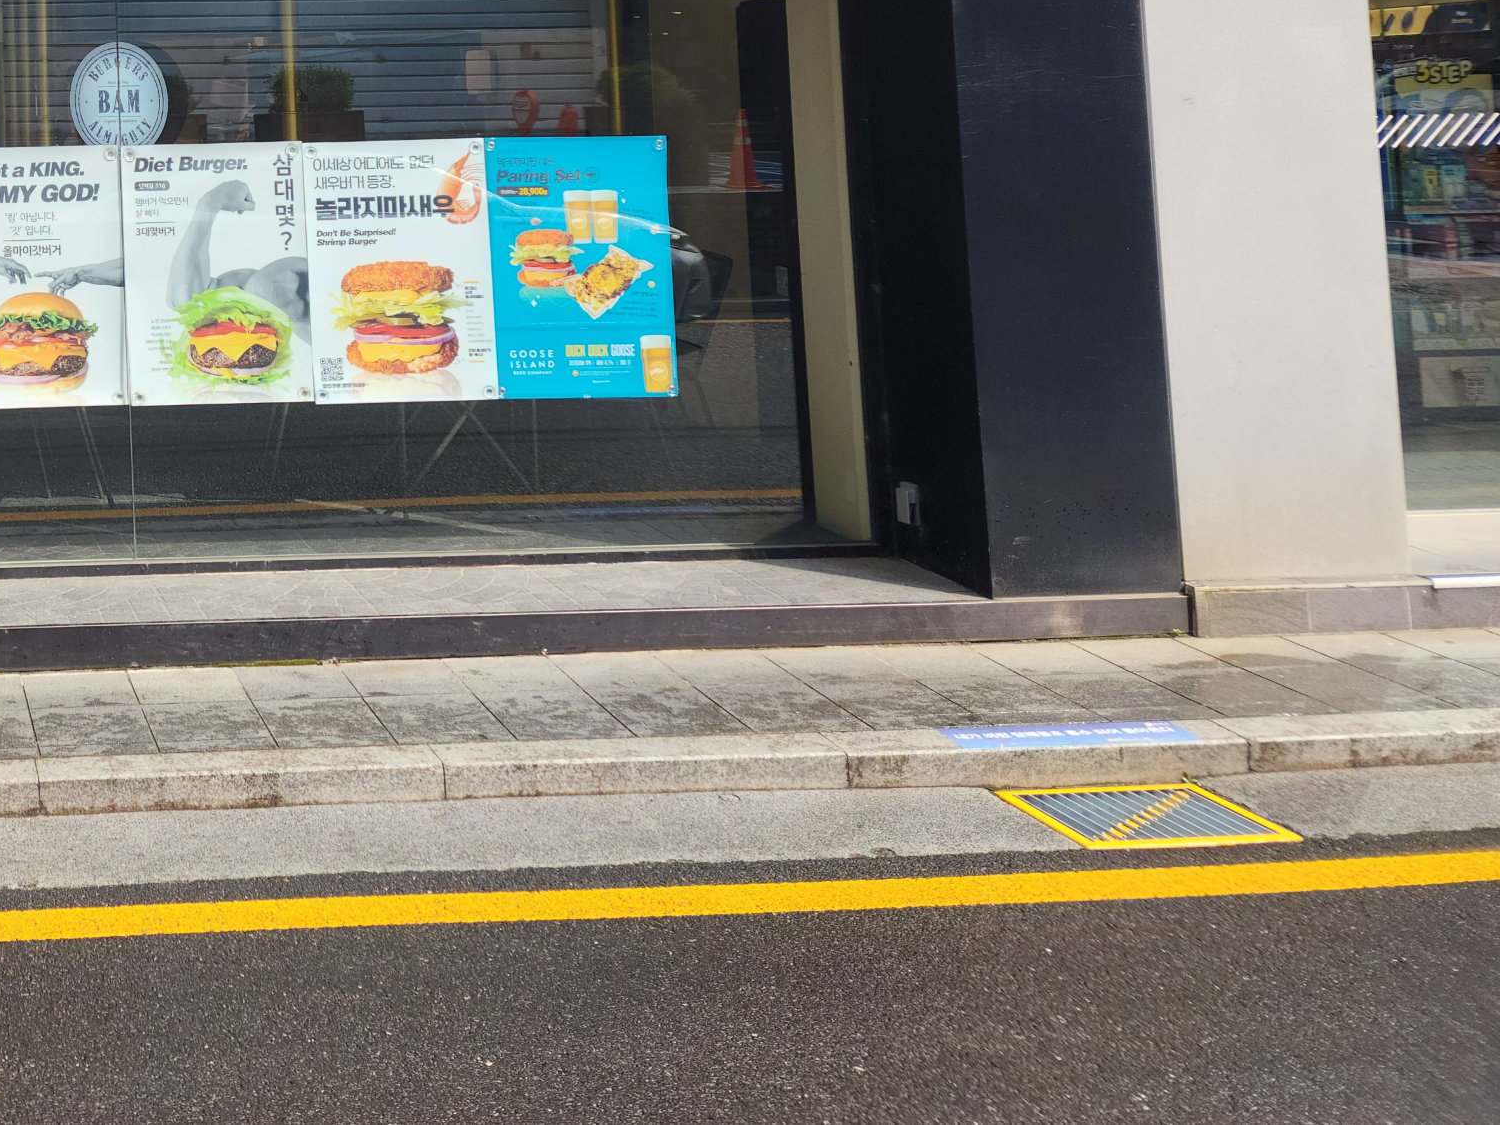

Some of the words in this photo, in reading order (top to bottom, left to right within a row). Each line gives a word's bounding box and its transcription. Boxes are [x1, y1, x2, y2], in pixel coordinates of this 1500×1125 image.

[88, 56, 149, 83] BURGERS
[98, 89, 141, 114] BAM
[88, 118, 152, 146] ALMIGHTY
[12, 165, 25, 178] a
[29, 161, 85, 177] KING.
[134, 156, 174, 173] Diet
[178, 155, 248, 174] Burger.
[312, 157, 352, 173] 이세상
[353, 156, 406, 171] 어디에도
[408, 154, 435, 170] 없던
[313, 175, 365, 191] 새우버거
[366, 174, 397, 190] 등장.
[496, 169, 550, 185] Paring
[554, 168, 582, 183] Set
[41, 183, 100, 203] GOD!
[158, 196, 190, 206] 먹으면서
[315, 194, 456, 222] 놀라지마새우
[135, 226, 177, 237] 3대몇버거
[316, 229, 339, 238] Don't
[340, 229, 352, 237] Be
[353, 228, 397, 238] Surprised!
[3, 244, 62, 257] 올마이갓버거
[316, 238, 347, 247] Shrimp
[348, 238, 378, 247] Burger
[509, 349, 555, 359] GOOSE
[610, 343, 636, 357] GOOSE
[510, 360, 556, 369] ISLAND
